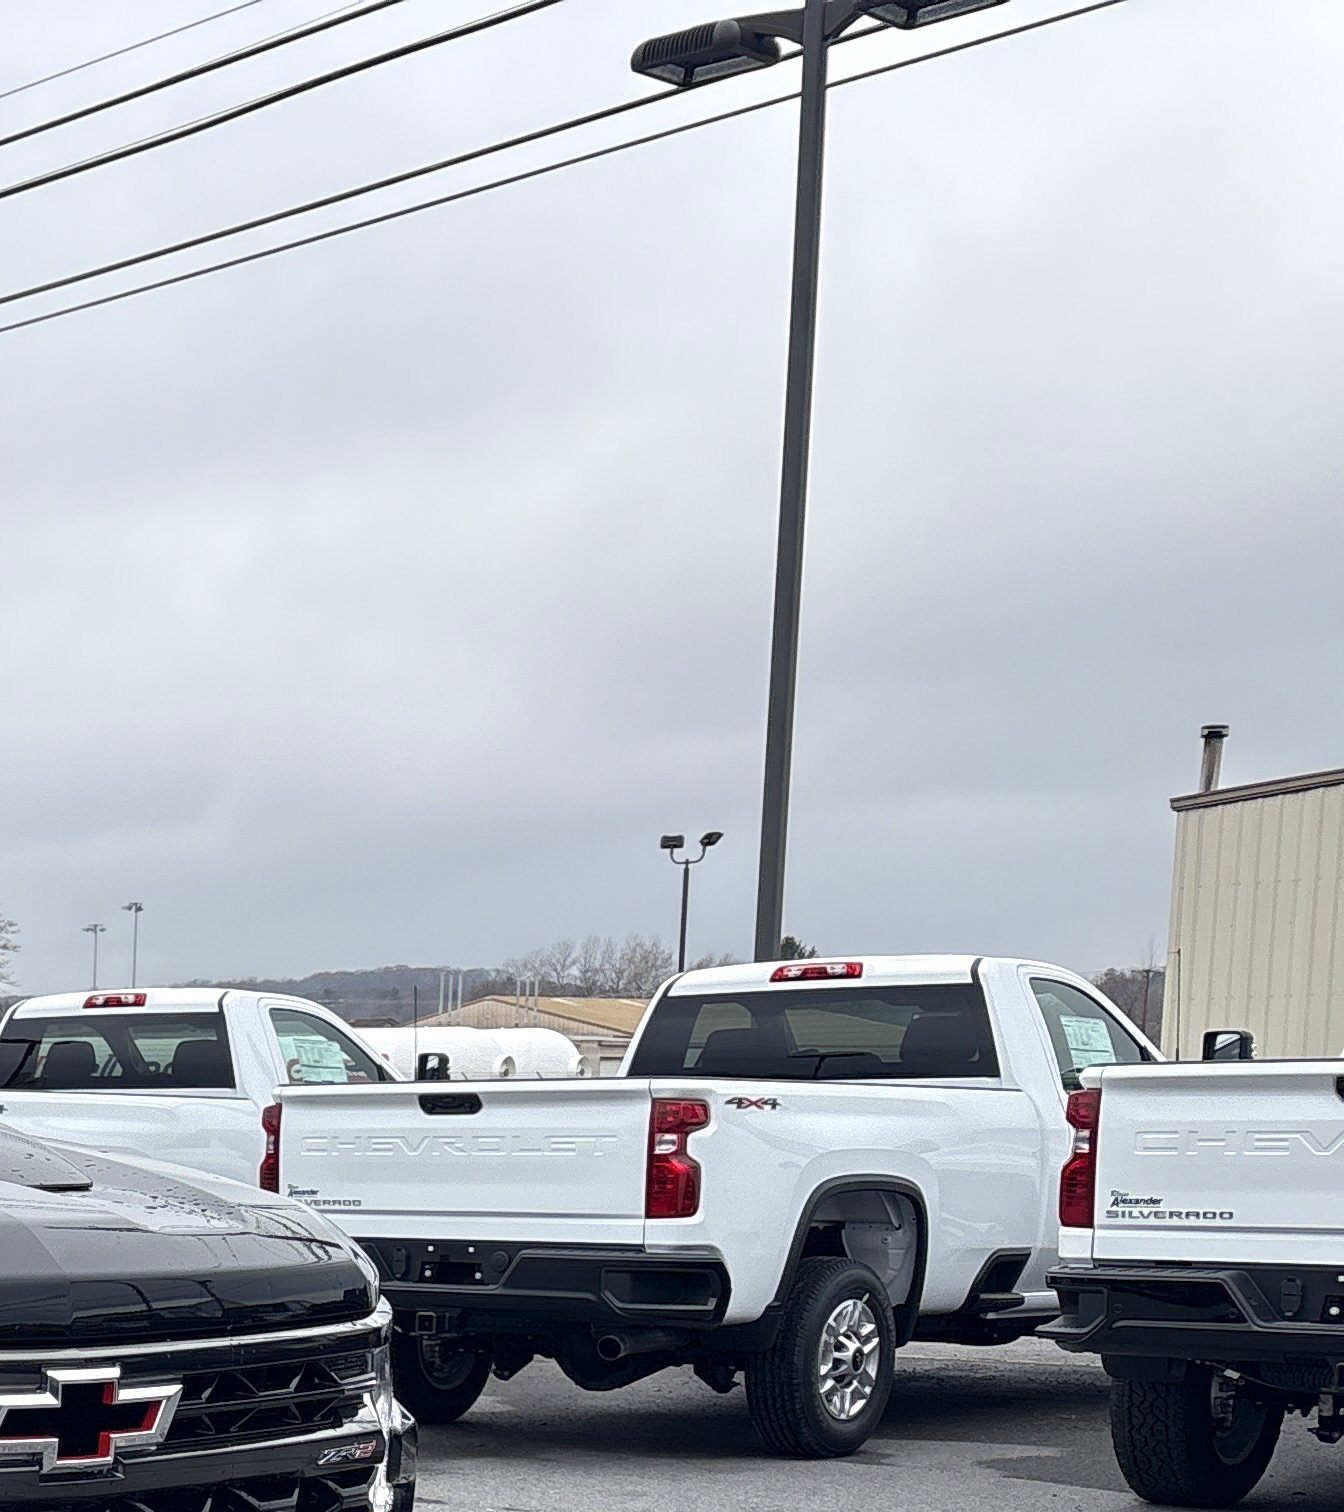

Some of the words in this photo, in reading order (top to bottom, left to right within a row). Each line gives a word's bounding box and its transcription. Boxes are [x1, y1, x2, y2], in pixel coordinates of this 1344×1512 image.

[300, 1135, 618, 1156] CHEVROLET
[1105, 1209, 1234, 1220] SILVERADO
[316, 1439, 377, 1465] ZR2
